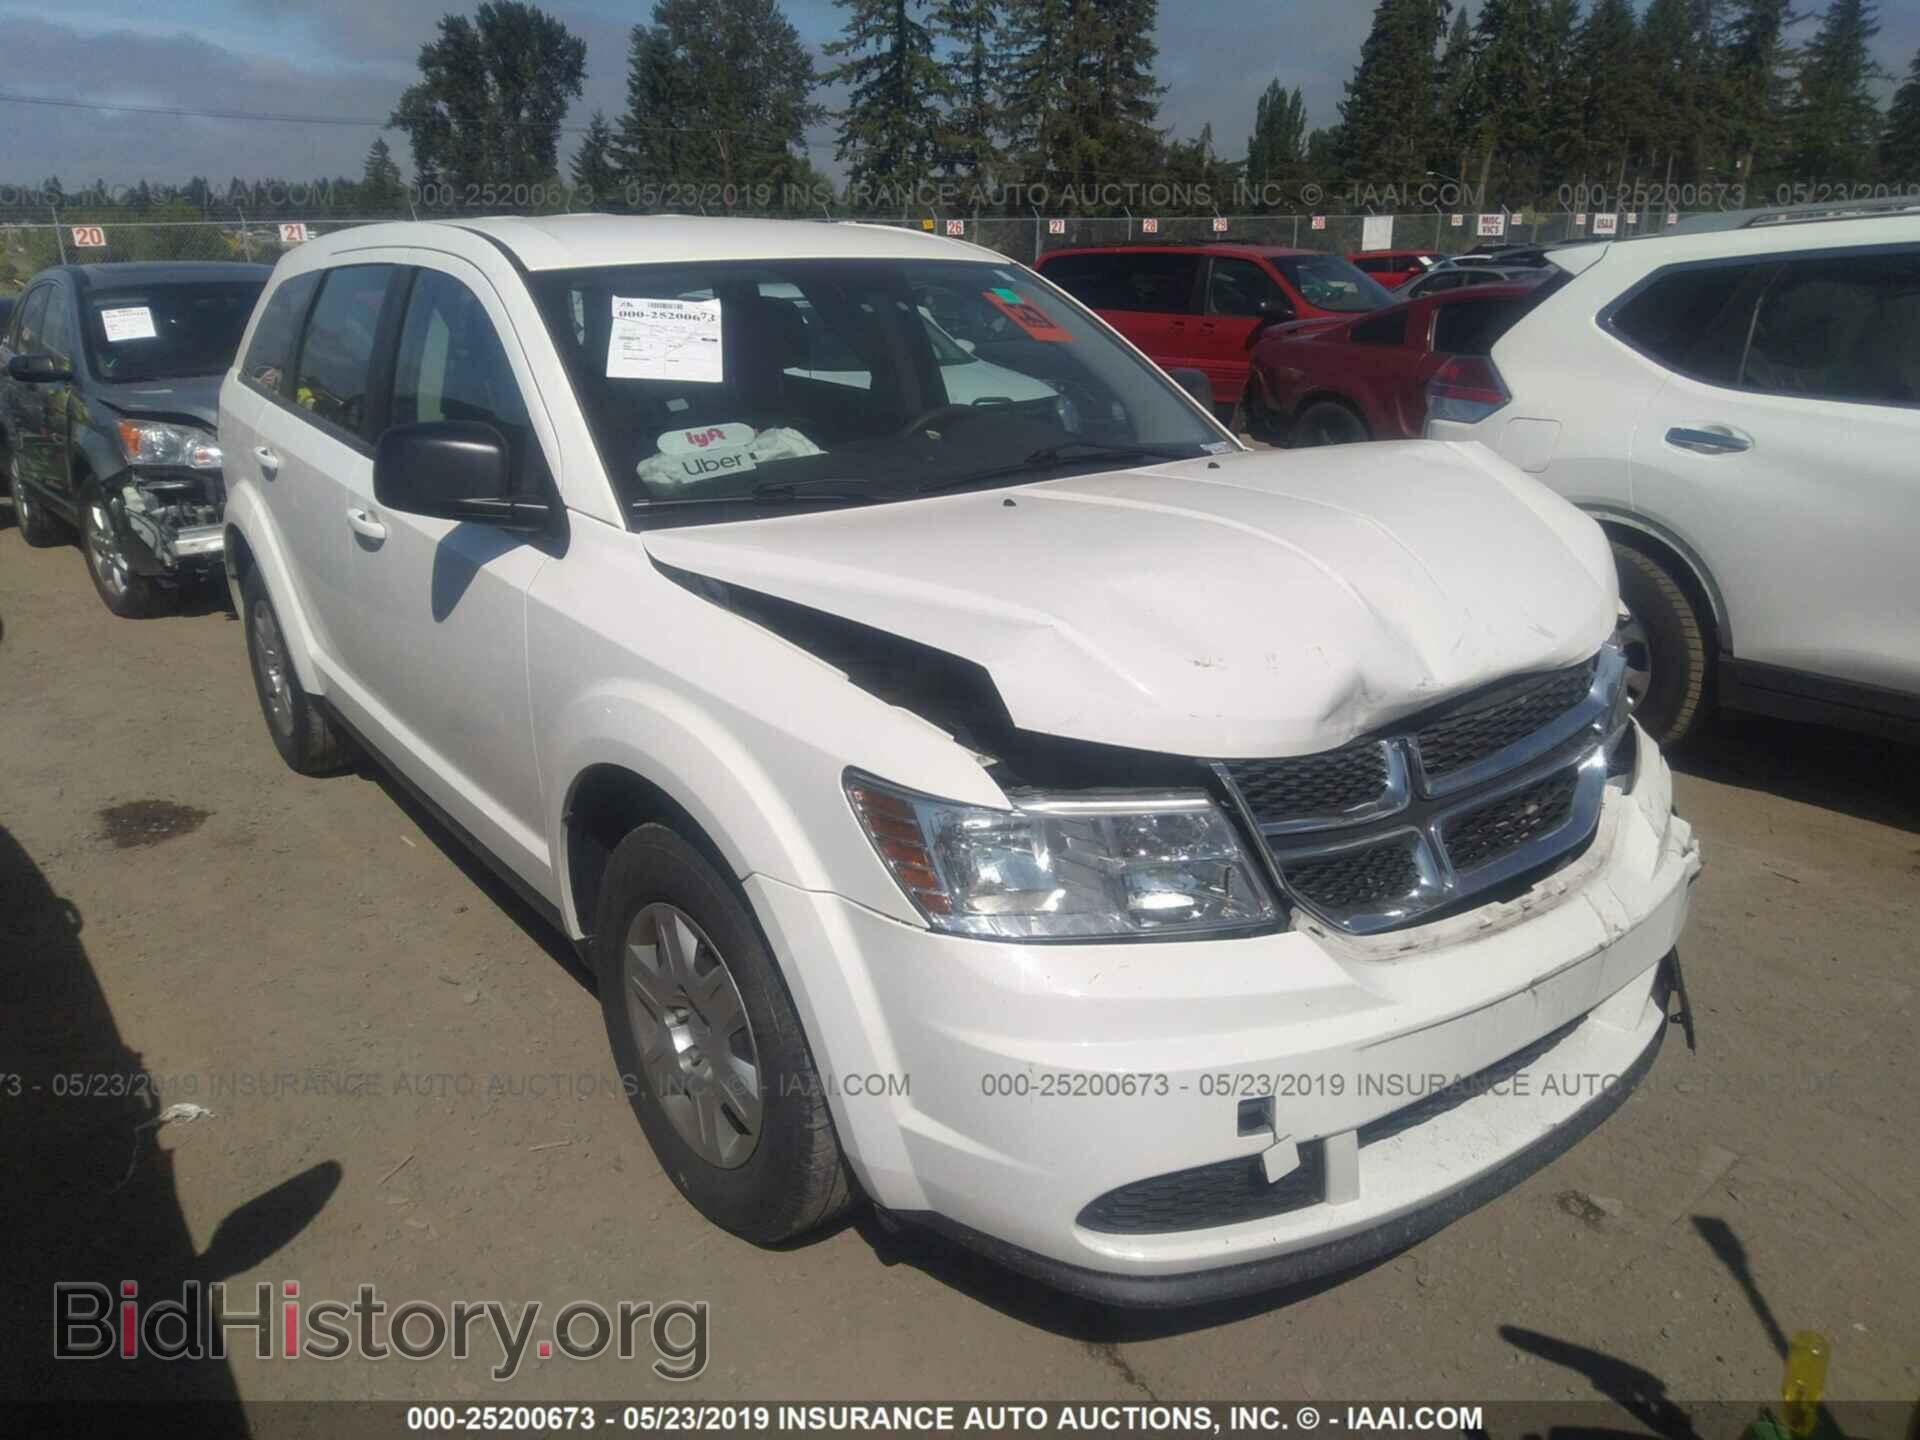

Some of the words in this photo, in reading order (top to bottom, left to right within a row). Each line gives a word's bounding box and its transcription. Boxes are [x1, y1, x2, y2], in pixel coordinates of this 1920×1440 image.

[283, 225, 304, 241] 21
[948, 221, 962, 234] 26
[1051, 220, 1063, 233] 27
[75, 228, 103, 245] 20
[681, 452, 745, 476] Uber
